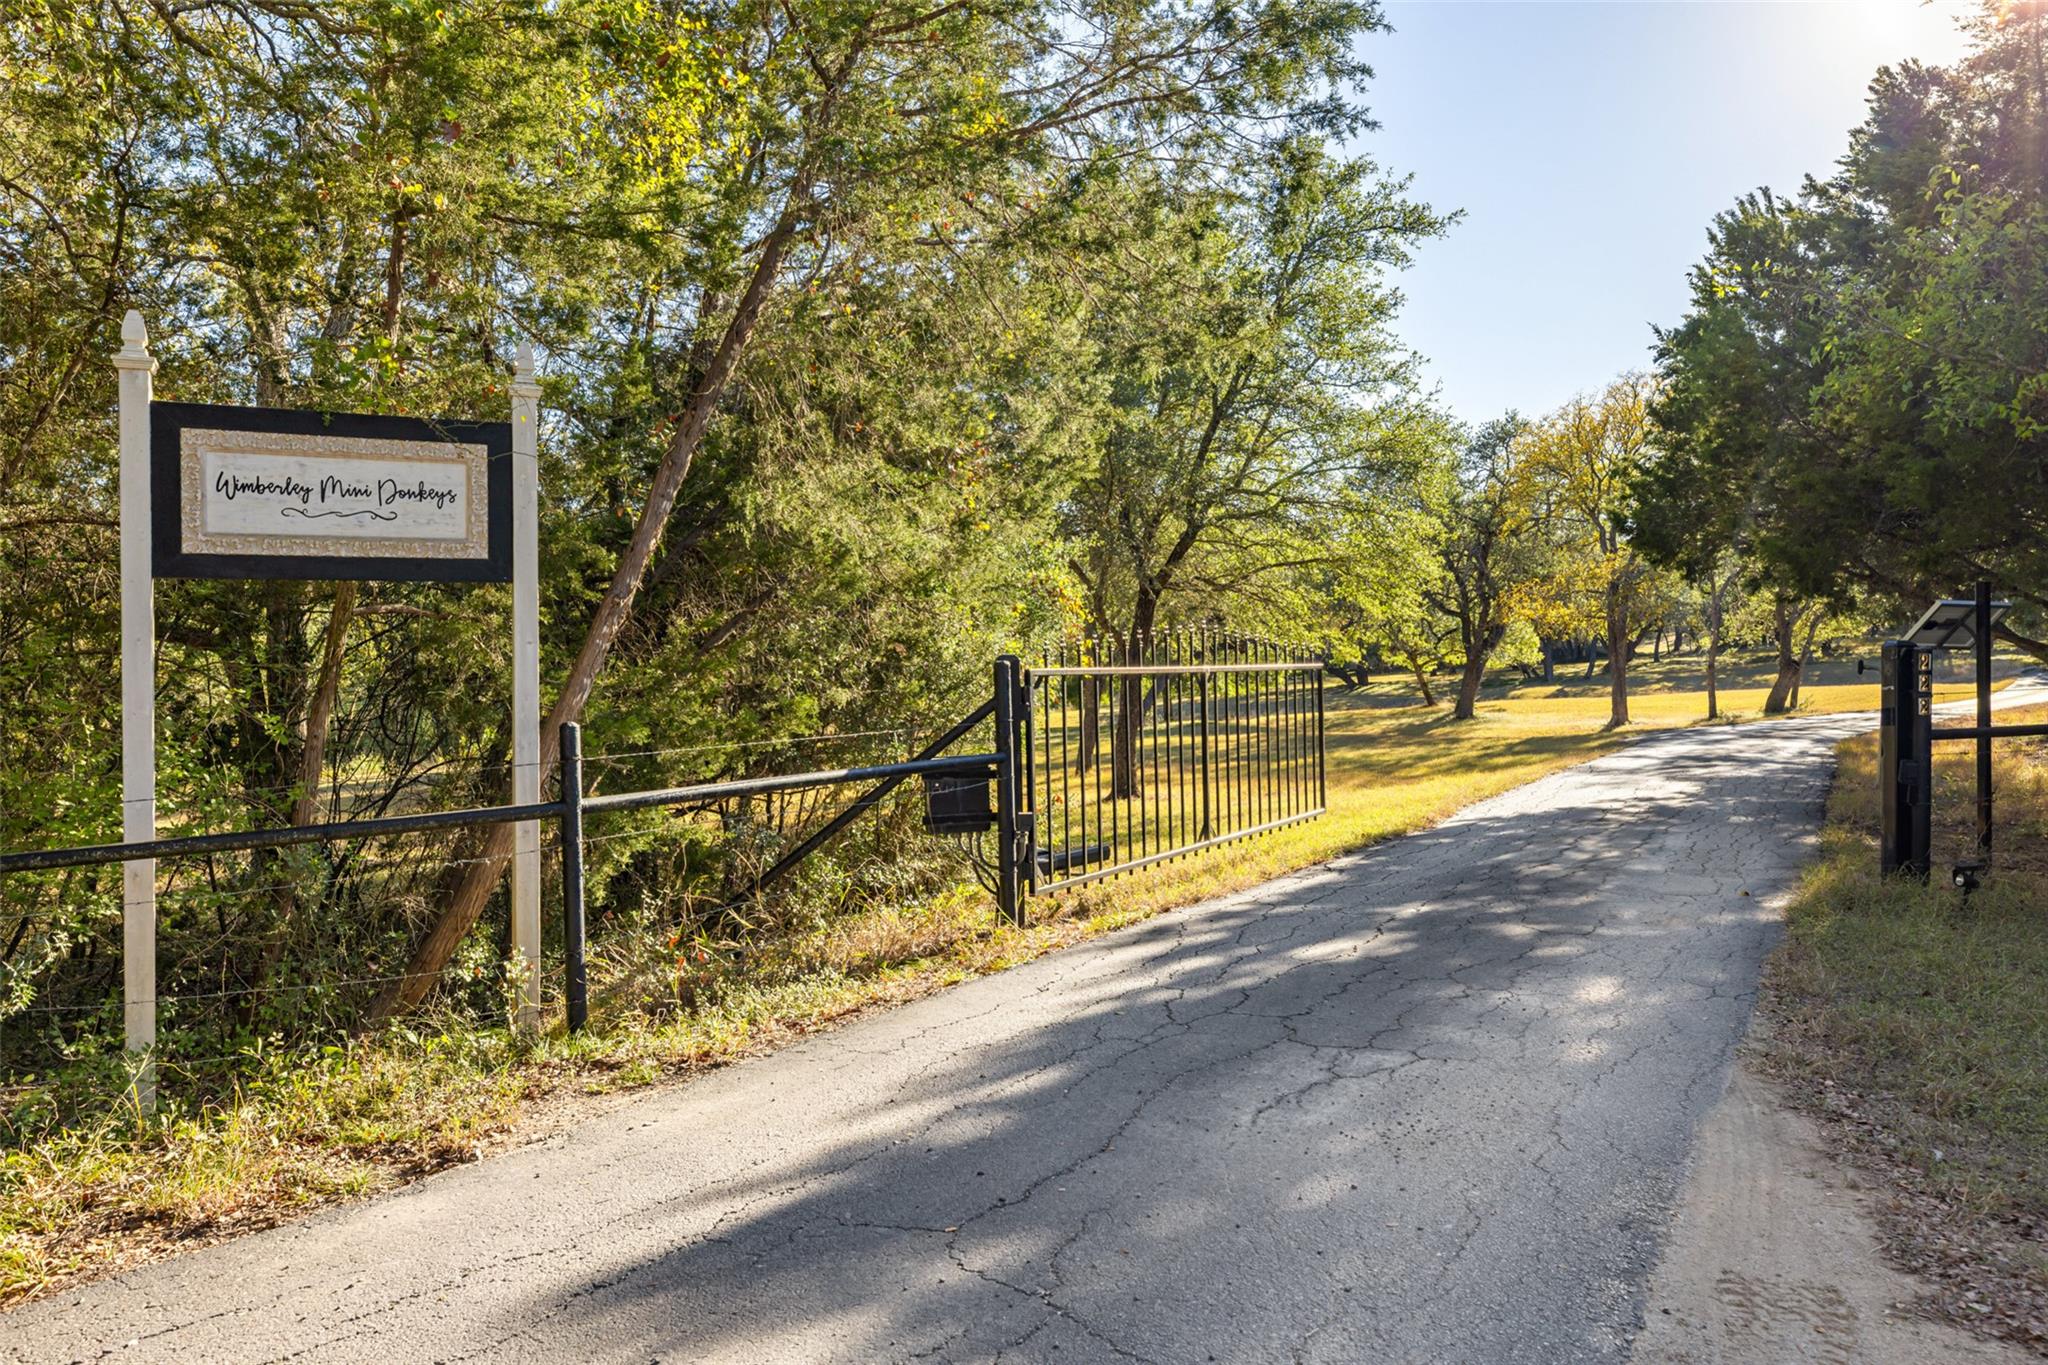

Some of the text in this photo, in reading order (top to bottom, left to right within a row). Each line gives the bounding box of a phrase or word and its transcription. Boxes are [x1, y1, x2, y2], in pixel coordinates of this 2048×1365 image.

[215, 471, 458, 509] Wimberley Mini Donkeys
